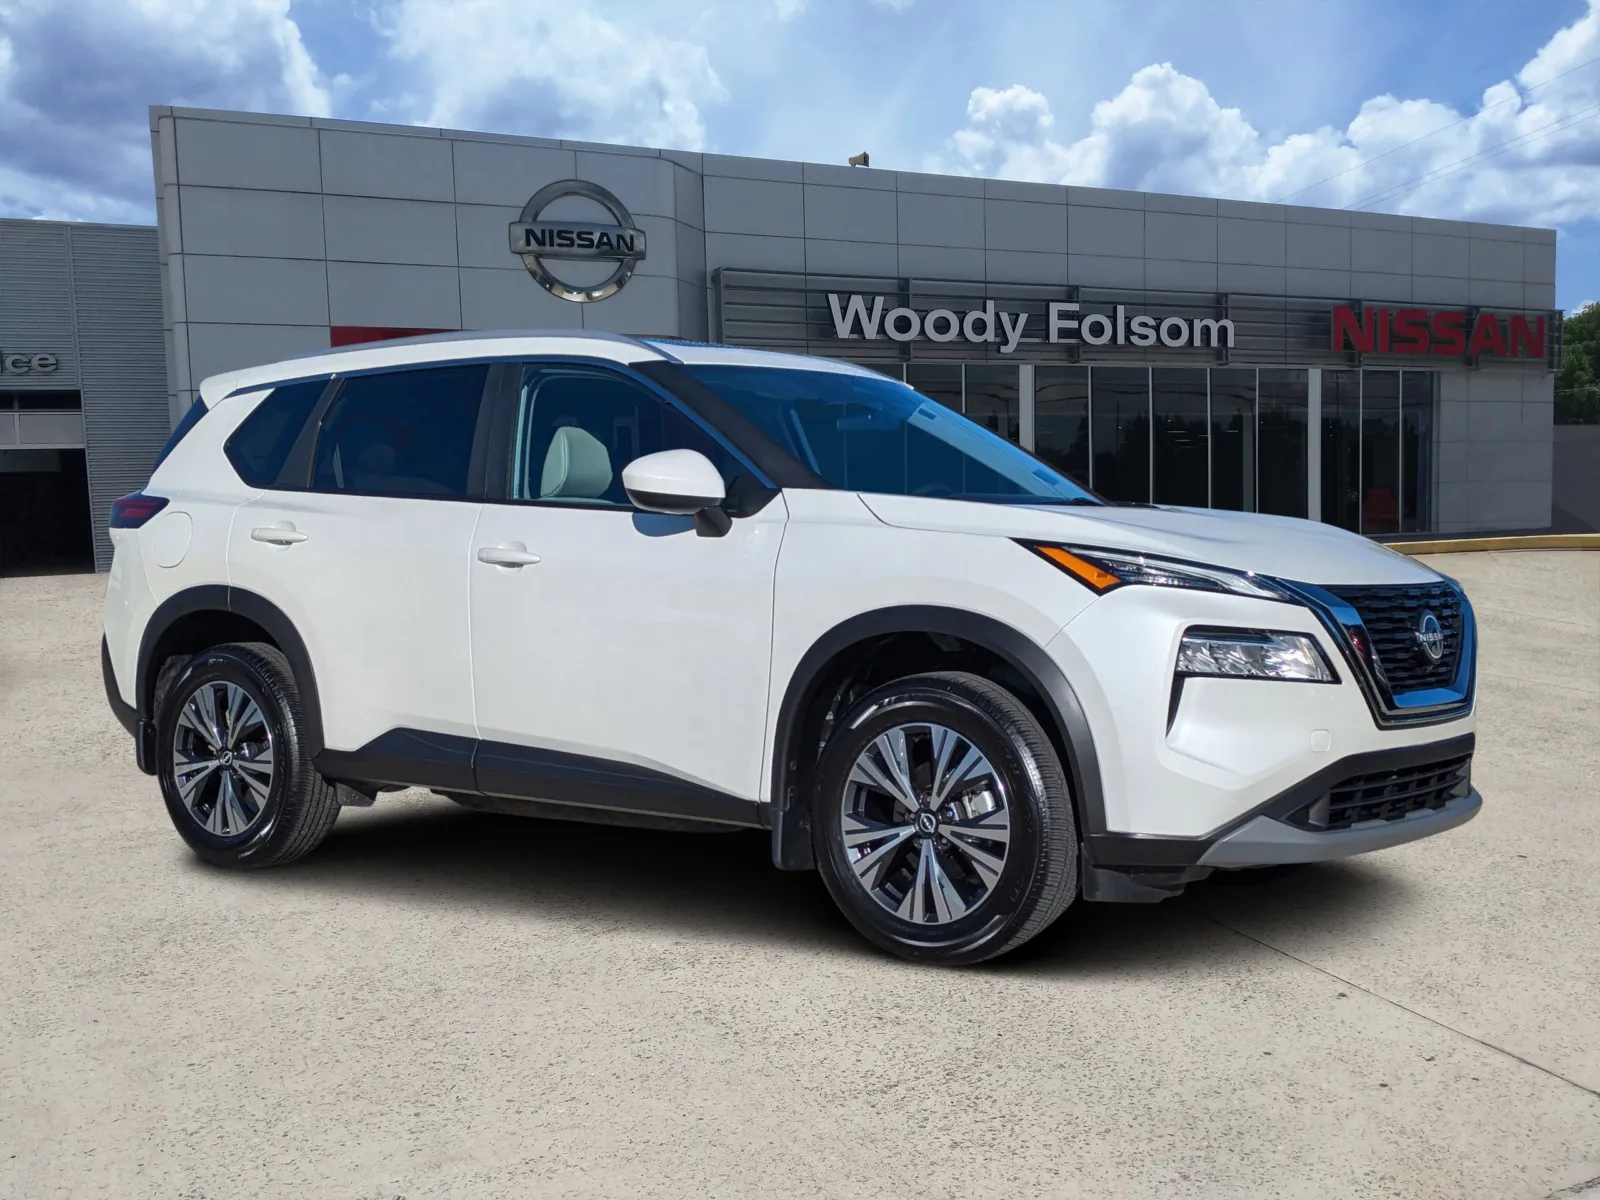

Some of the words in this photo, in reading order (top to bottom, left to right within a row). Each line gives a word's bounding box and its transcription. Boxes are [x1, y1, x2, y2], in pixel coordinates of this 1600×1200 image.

[524, 228, 635, 252] NISSAN
[827, 293, 1028, 353] Woody
[1046, 302, 1236, 347] Folsom
[1332, 305, 1545, 358] NISSAN
[0, 353, 57, 373] ce
